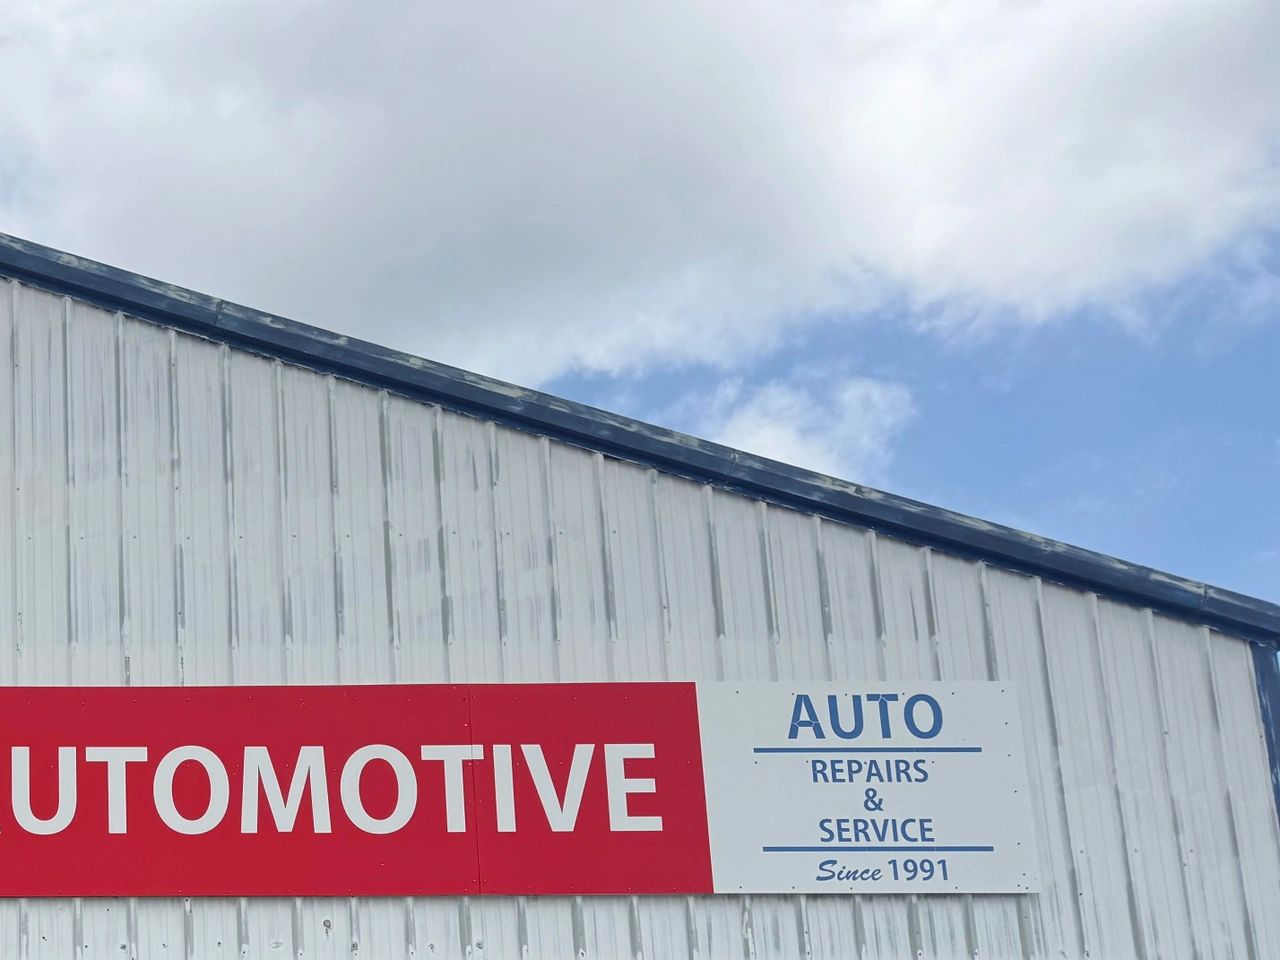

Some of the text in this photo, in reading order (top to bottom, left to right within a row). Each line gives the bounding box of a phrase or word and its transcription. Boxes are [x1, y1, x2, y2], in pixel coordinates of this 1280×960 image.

[787, 693, 943, 740] AUTO
[811, 759, 929, 783] REPAIRS
[863, 787, 884, 812] &
[818, 818, 935, 843] SERVICE
[815, 858, 949, 883] Since 1991
